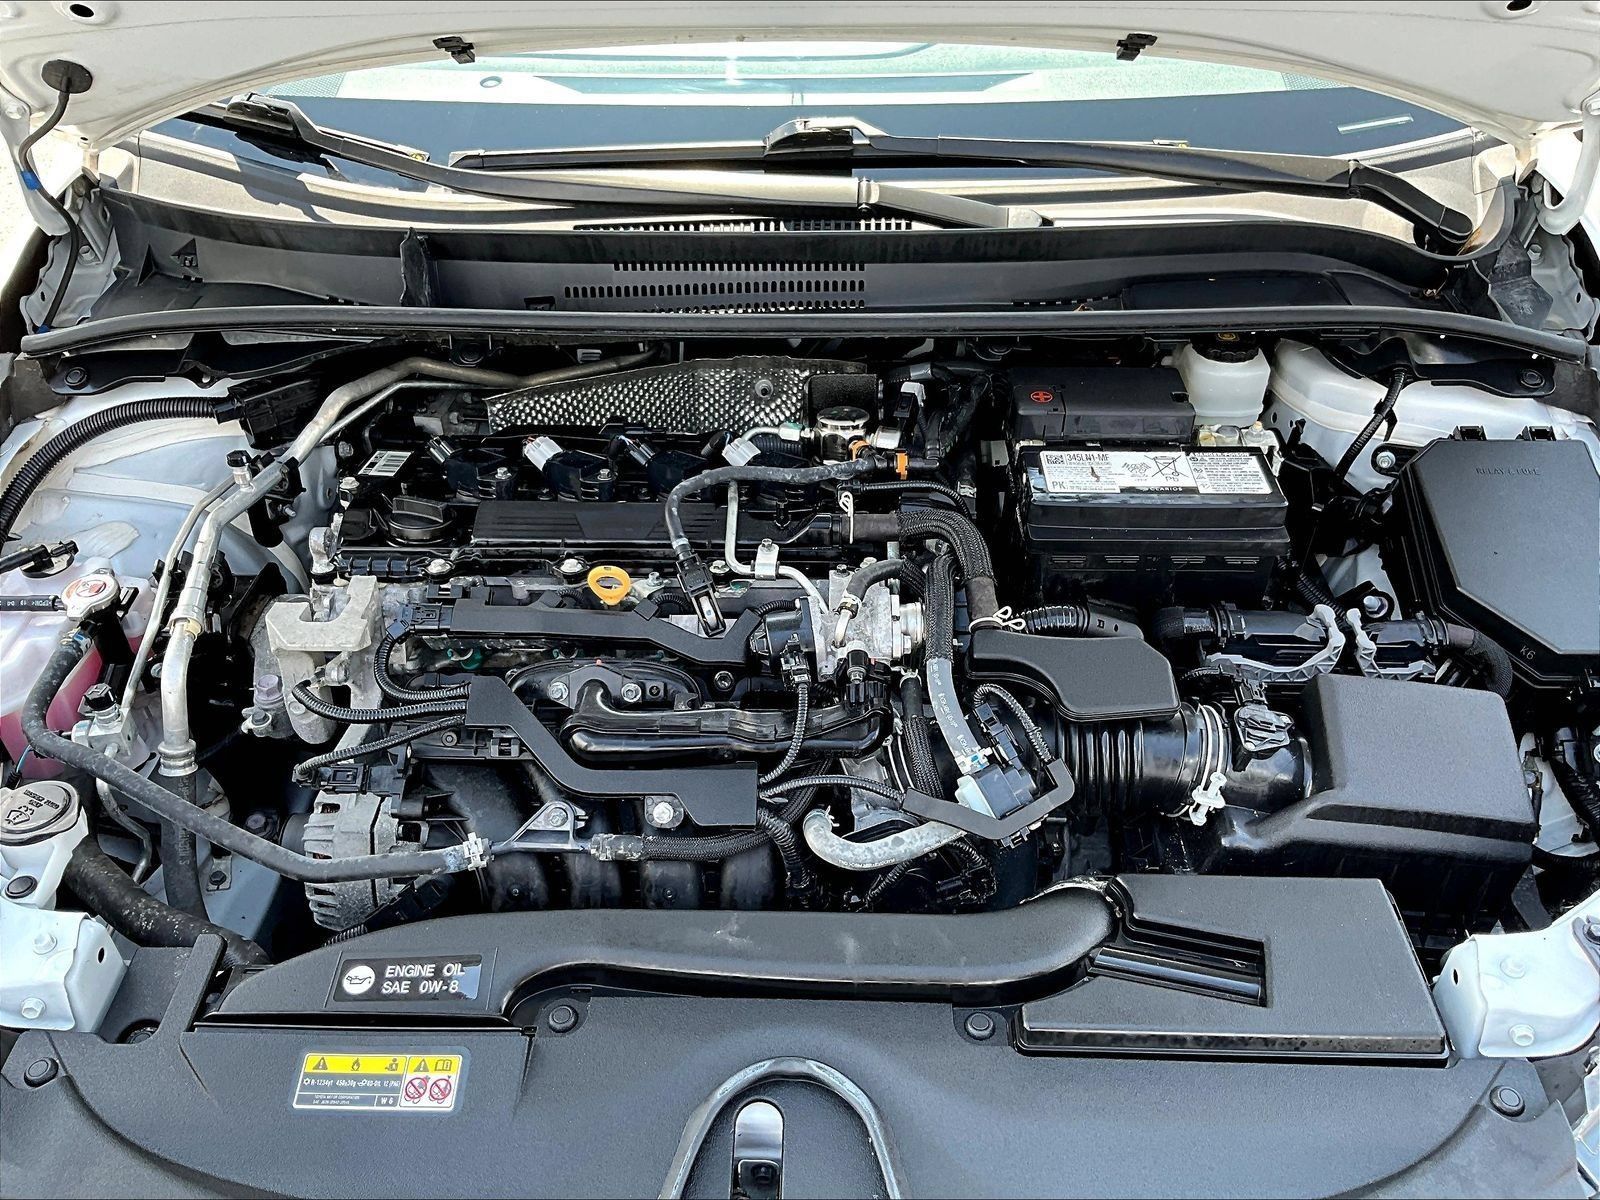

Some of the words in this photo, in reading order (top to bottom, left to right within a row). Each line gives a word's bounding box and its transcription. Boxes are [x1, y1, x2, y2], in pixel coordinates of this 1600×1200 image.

[385, 964, 436, 978] ENGINE
[442, 963, 466, 976] OIL
[381, 981, 412, 994] SAE
[419, 980, 459, 994] 0W-8
[381, 1097, 389, 1105] W
